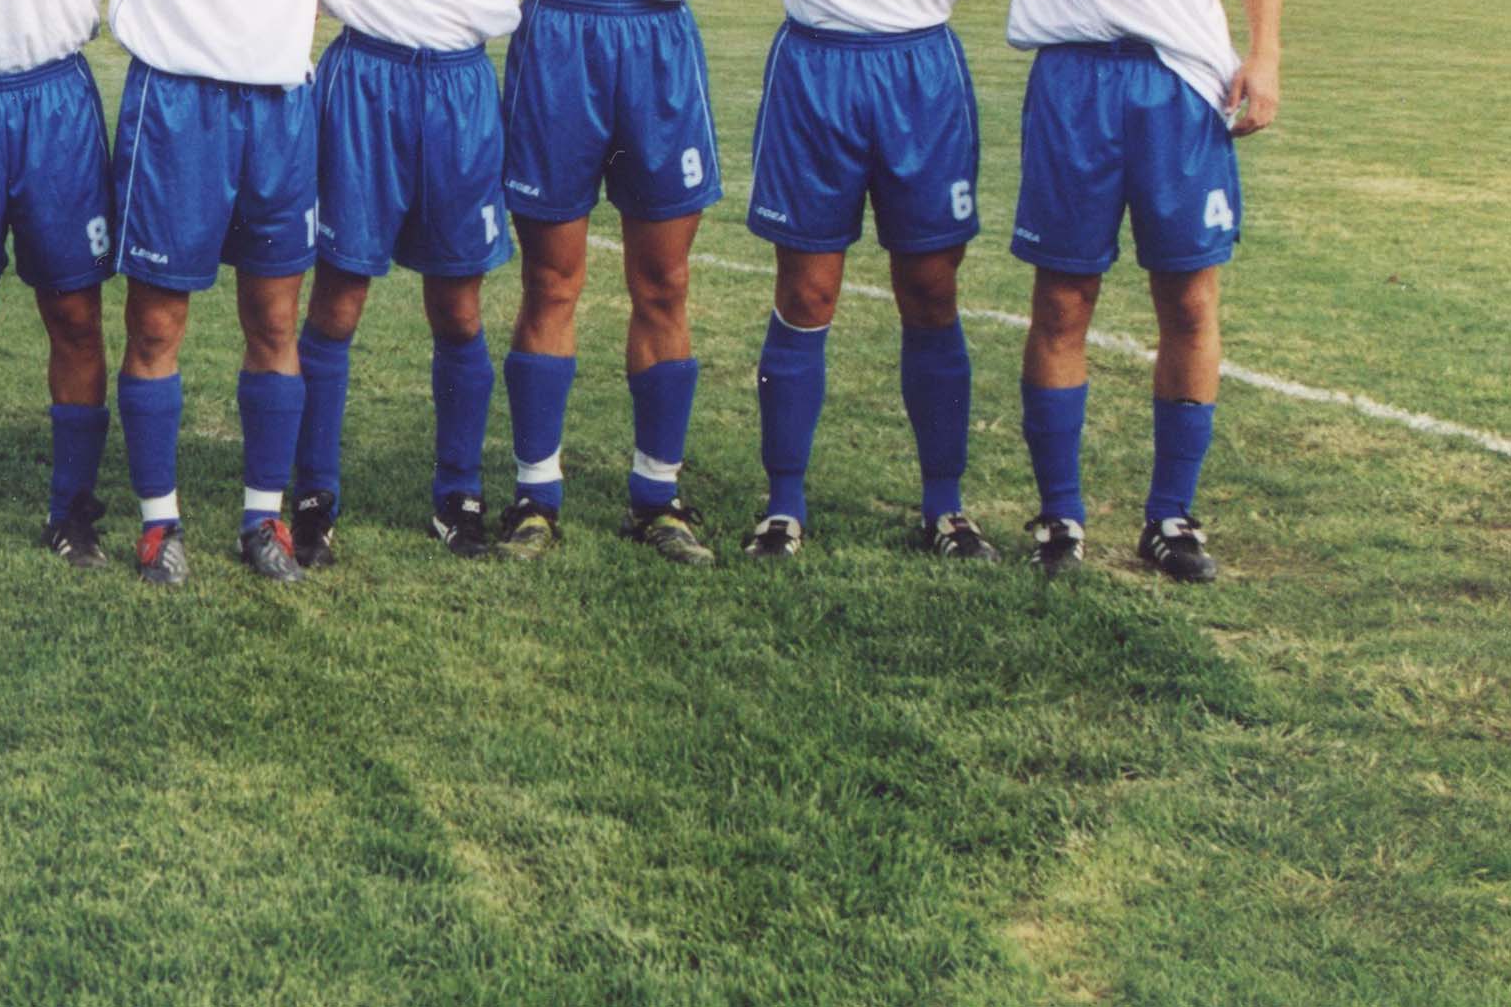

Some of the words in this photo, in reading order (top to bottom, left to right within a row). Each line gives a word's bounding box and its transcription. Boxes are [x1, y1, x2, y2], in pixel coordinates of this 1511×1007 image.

[681, 147, 704, 189] 9
[951, 179, 974, 221] 6
[1203, 189, 1234, 232] 4
[87, 215, 110, 257] 8
